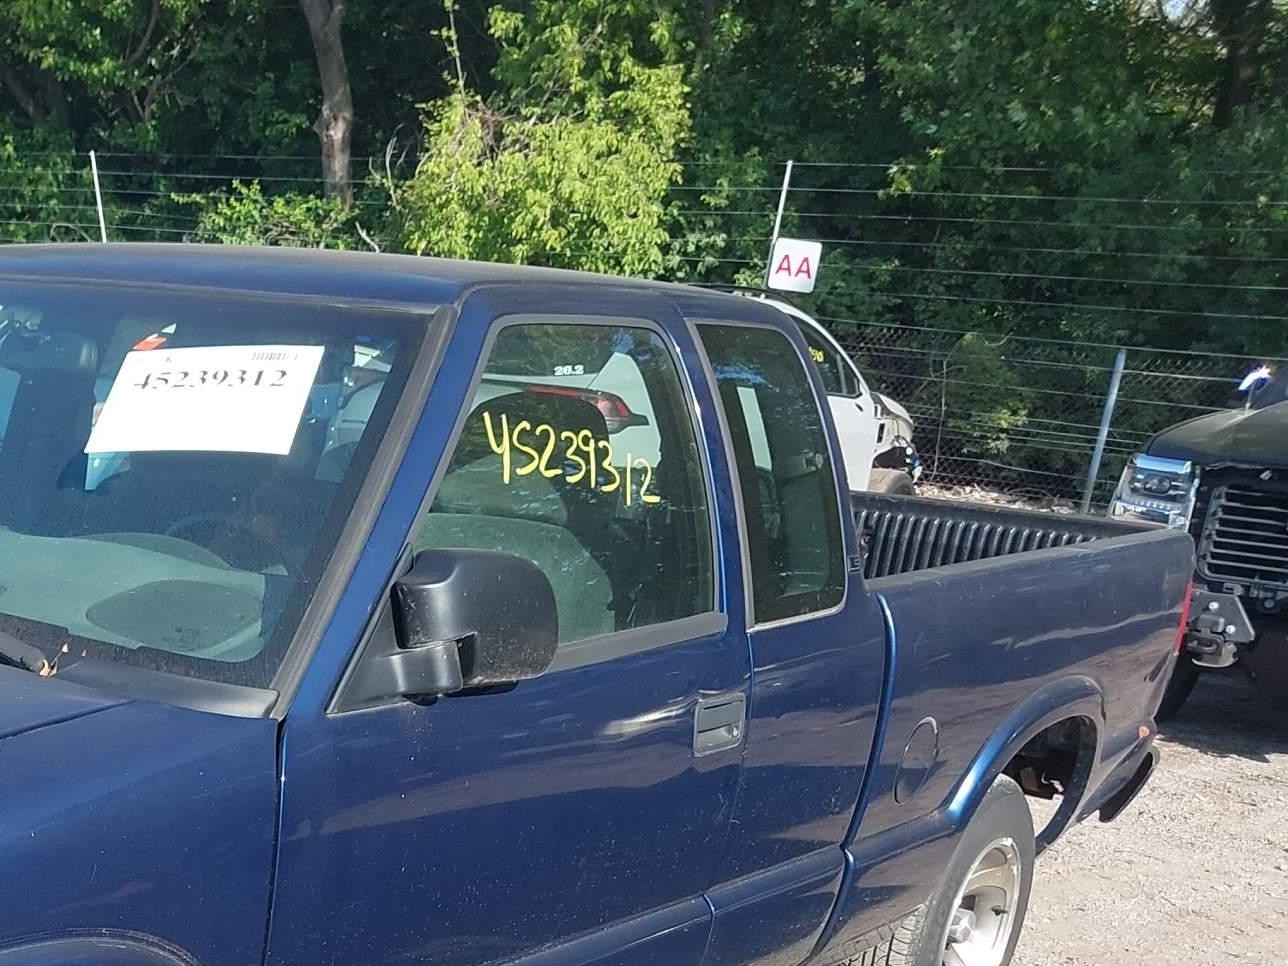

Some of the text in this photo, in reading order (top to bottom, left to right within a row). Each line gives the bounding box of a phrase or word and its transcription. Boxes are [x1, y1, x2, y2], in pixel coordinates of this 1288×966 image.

[775, 254, 812, 279] AA
[133, 368, 288, 390] 45239312
[482, 411, 661, 507] 45239312
